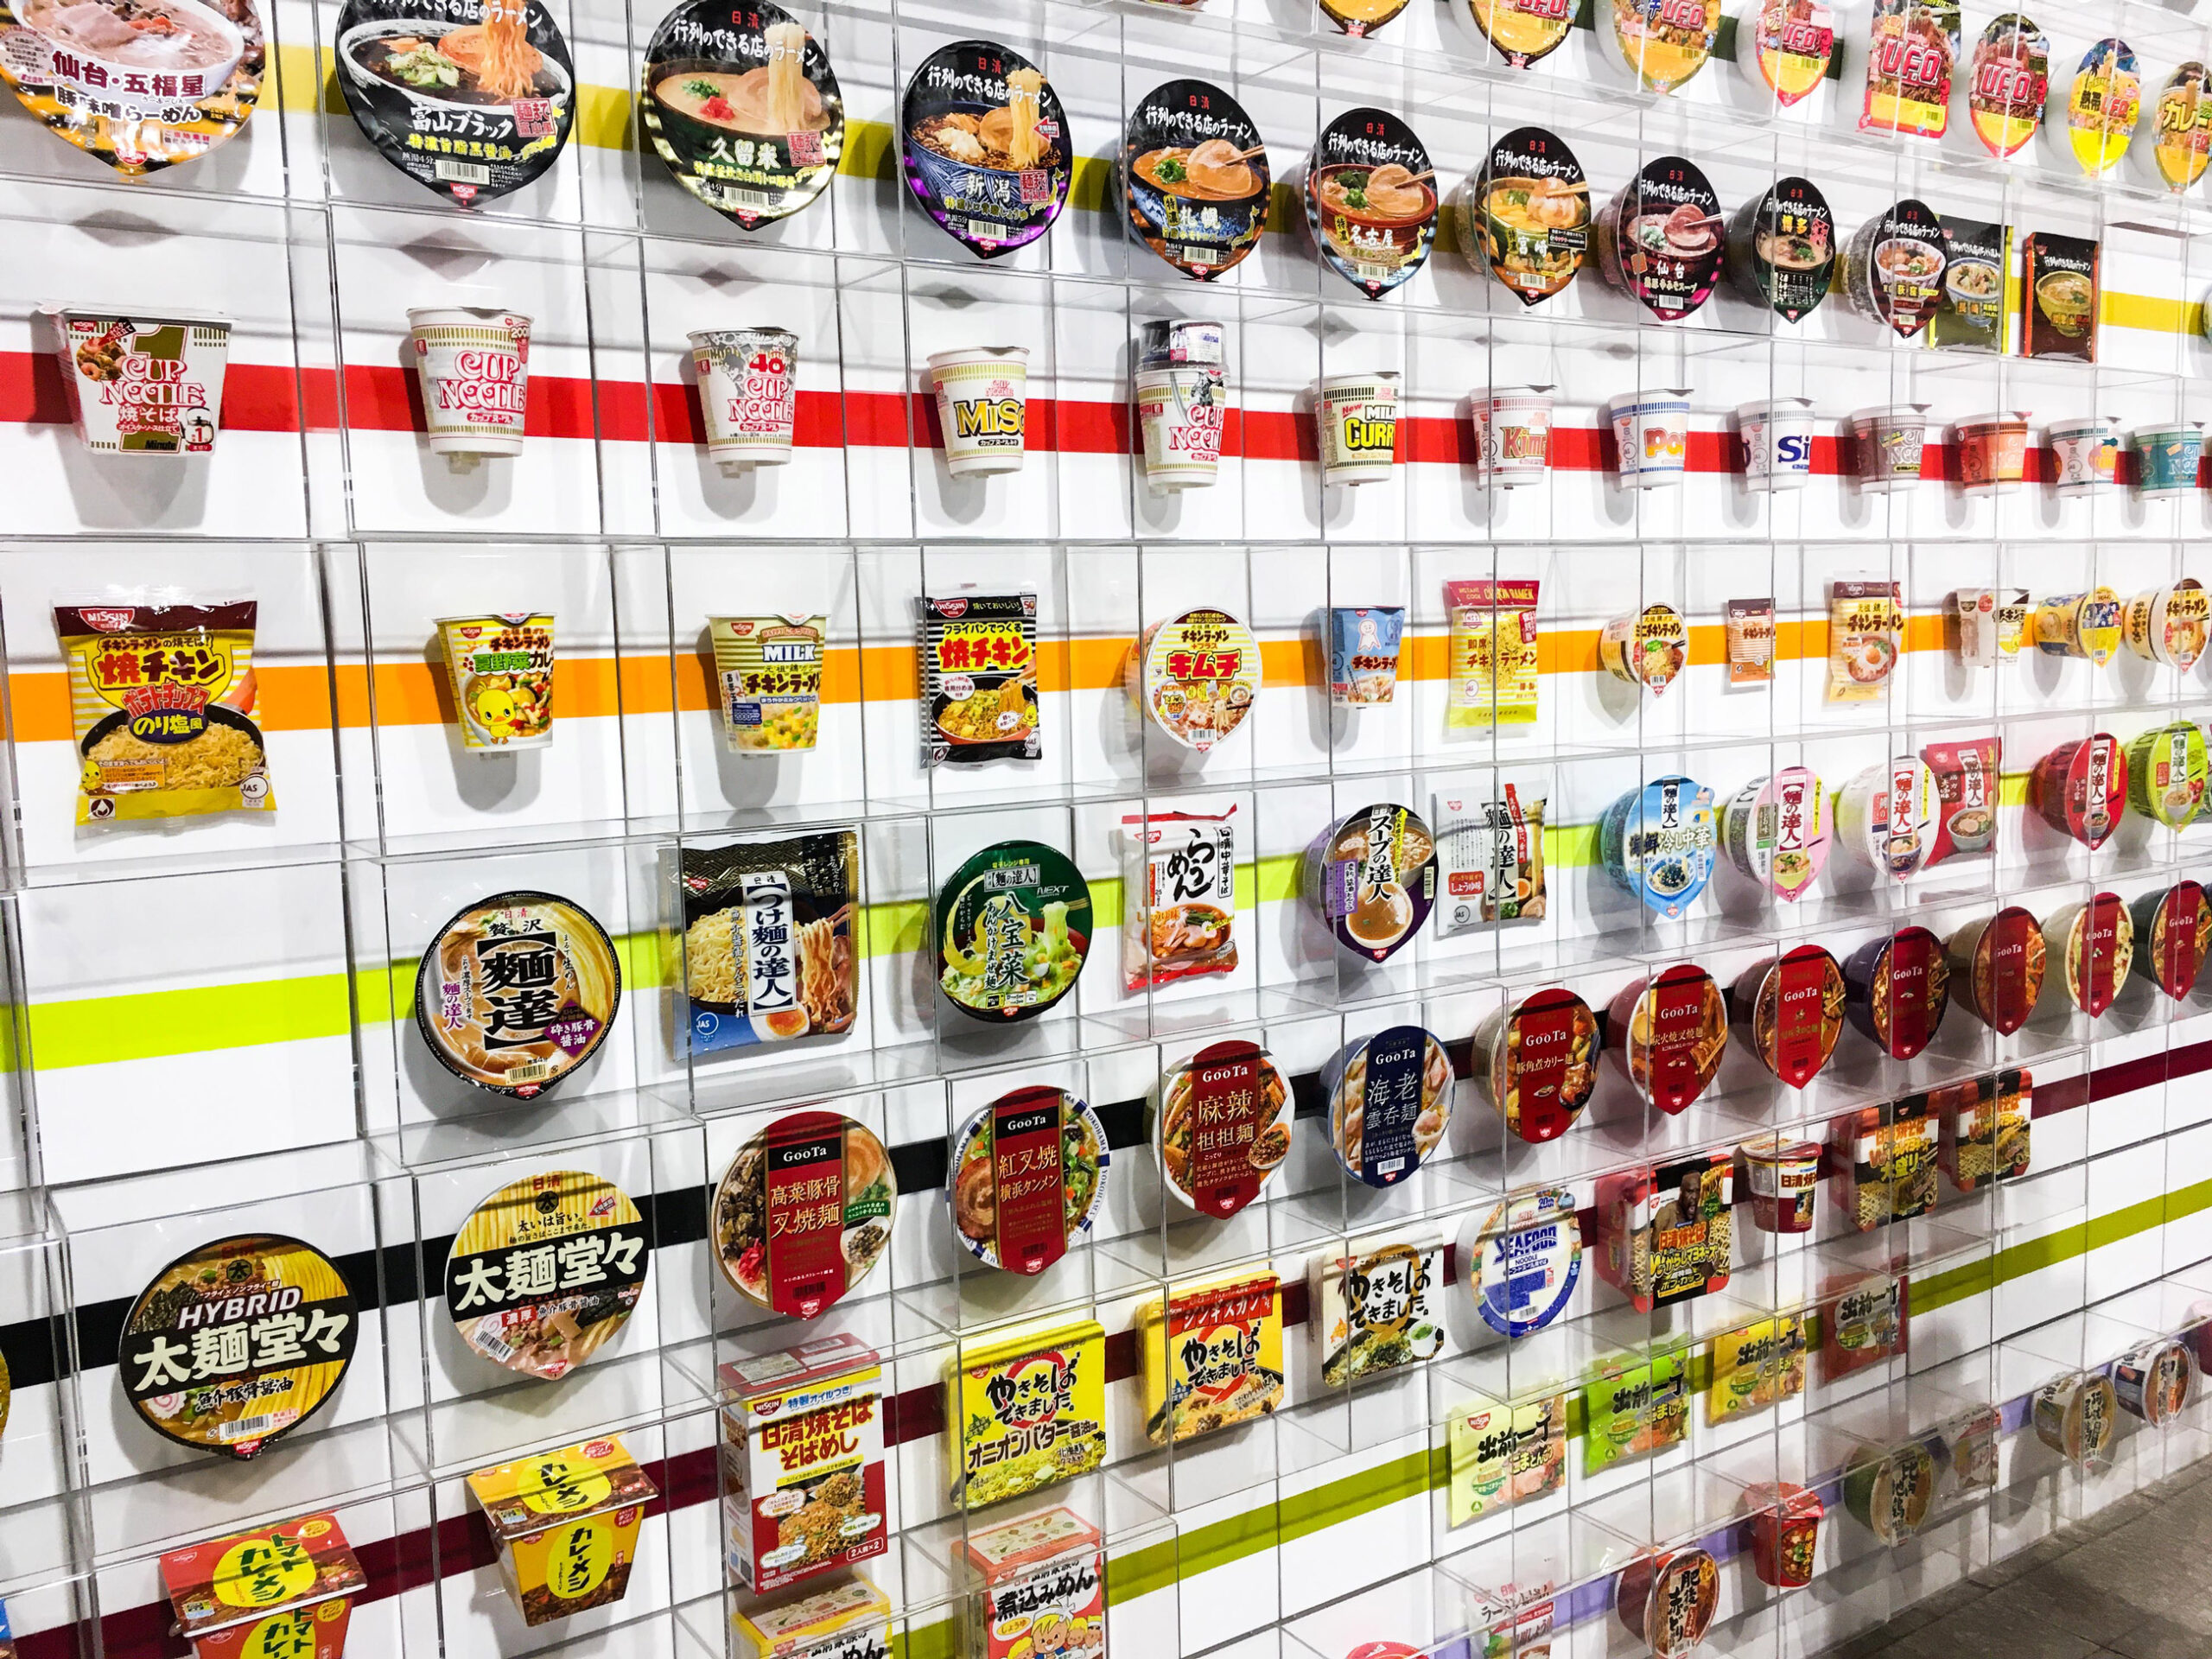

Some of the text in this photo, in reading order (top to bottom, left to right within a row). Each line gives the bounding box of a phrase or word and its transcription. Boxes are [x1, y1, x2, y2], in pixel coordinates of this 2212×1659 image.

[673, 19, 818, 67] 行列のできる店のラーメン
[927, 65, 1052, 108] 行列のできる店のラーメン
[410, 102, 513, 138] 富山ブラック
[1146, 105, 1252, 139] 行列のできる店のラーメン
[709, 136, 781, 170] 久留米
[1328, 131, 1423, 163] 行列のできる店のラーメン
[1350, 224, 1395, 249] 名古屋
[122, 357, 188, 382] CUP
[455, 350, 520, 382] CUP
[99, 380, 207, 407] NOODLE
[437, 379, 525, 414] NOODLE
[744, 376, 789, 399] CUP
[119, 407, 178, 422] 焼そば
[1344, 417, 1395, 450] CURR
[87, 610, 129, 622] NISSIN
[944, 623, 1023, 635] フライパンでつくる
[490, 636, 550, 652] チキンラーメン
[1181, 629, 1230, 643] チキンラーメン
[762, 645, 816, 662] MILK
[939, 636, 1029, 669] 焼チキン
[1167, 650, 1241, 680] キムチ
[98, 650, 219, 685] 焼チキン
[746, 673, 821, 694] チキンラーメン
[122, 683, 211, 717] ポテトチップス
[133, 715, 204, 735] のり塩風
[1037, 886, 1070, 895] NEXT
[488, 919, 544, 937] 贅沢
[998, 891, 1029, 987] 八宝菜
[1893, 966, 1923, 981] GooTa
[1784, 987, 1817, 1002] GooTa
[1661, 1004, 1698, 1020] GooTa
[1526, 1029, 1567, 1046] GooTa
[1376, 1048, 1416, 1065] GooTa
[1202, 1065, 1249, 1084] GooTa
[1197, 1089, 1255, 1127] 麻辣
[1007, 1116, 1046, 1131] GooTa
[784, 1146, 827, 1162] GooTa
[533, 1175, 561, 1191] 日清
[1000, 1175, 1059, 1203] 横浜タンメン
[1493, 1225, 1558, 1265] SEAFOOD
[454, 1231, 644, 1312] 太麺堂々
[178, 1288, 302, 1330] HYBRID
[506, 1310, 533, 1325] 濃厚
[133, 1308, 349, 1392] 太麺堂々
[1181, 1321, 1262, 1372] やきそば
[986, 1351, 1081, 1410] やきそば
[1611, 1371, 1684, 1414] 出前一丁
[756, 1401, 779, 1413] NISSIN
[787, 1385, 852, 1411] 特製オイルつき
[761, 1394, 874, 1452] 日清焼そば
[781, 1433, 859, 1471] そばめし
[1477, 1414, 1552, 1464] 出前一丁
[568, 1527, 593, 1593] カレーメシ
[996, 1567, 1095, 1622] 煮込みめん
